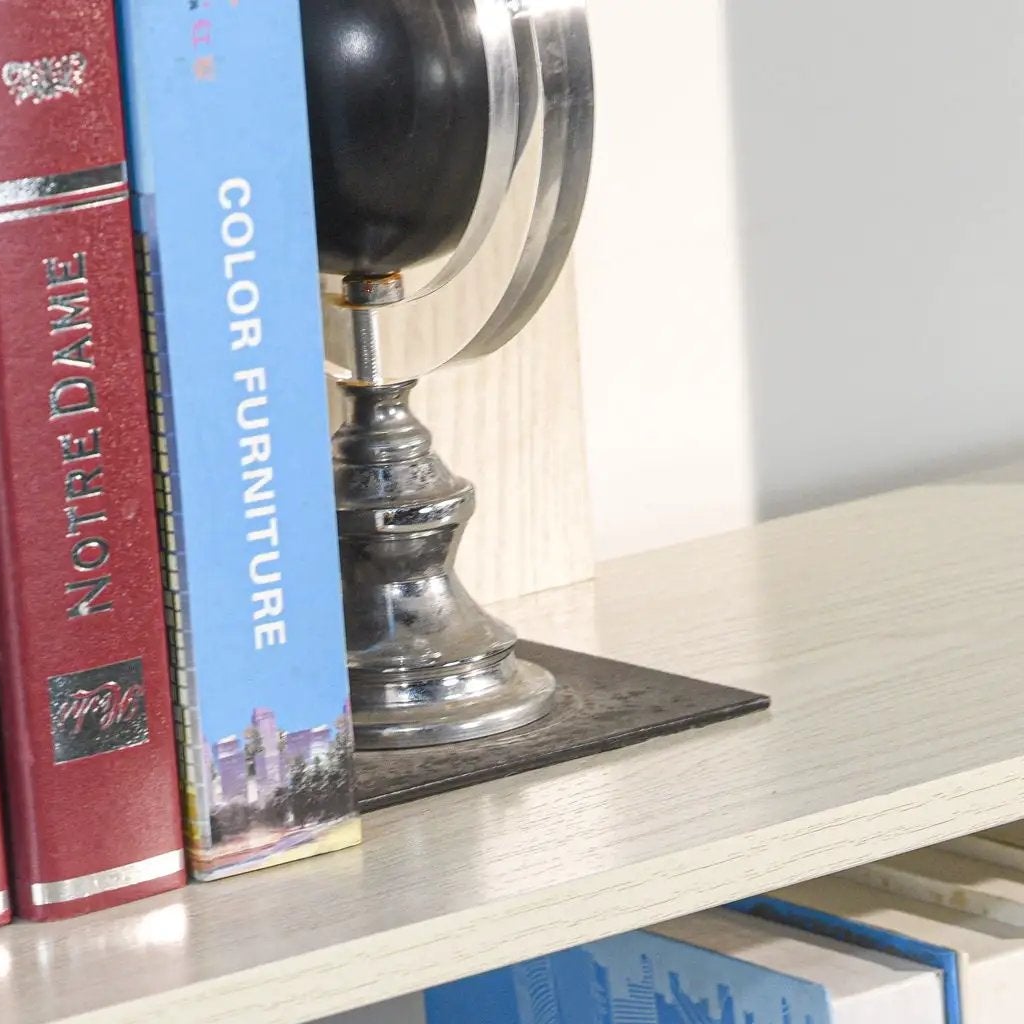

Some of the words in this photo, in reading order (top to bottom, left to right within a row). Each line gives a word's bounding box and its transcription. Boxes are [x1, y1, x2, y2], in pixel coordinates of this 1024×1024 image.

[42, 251, 100, 421] DAME
[217, 177, 263, 352] COLOR
[57, 427, 114, 620] NOTRE
[233, 367, 287, 650] FURNITURE
